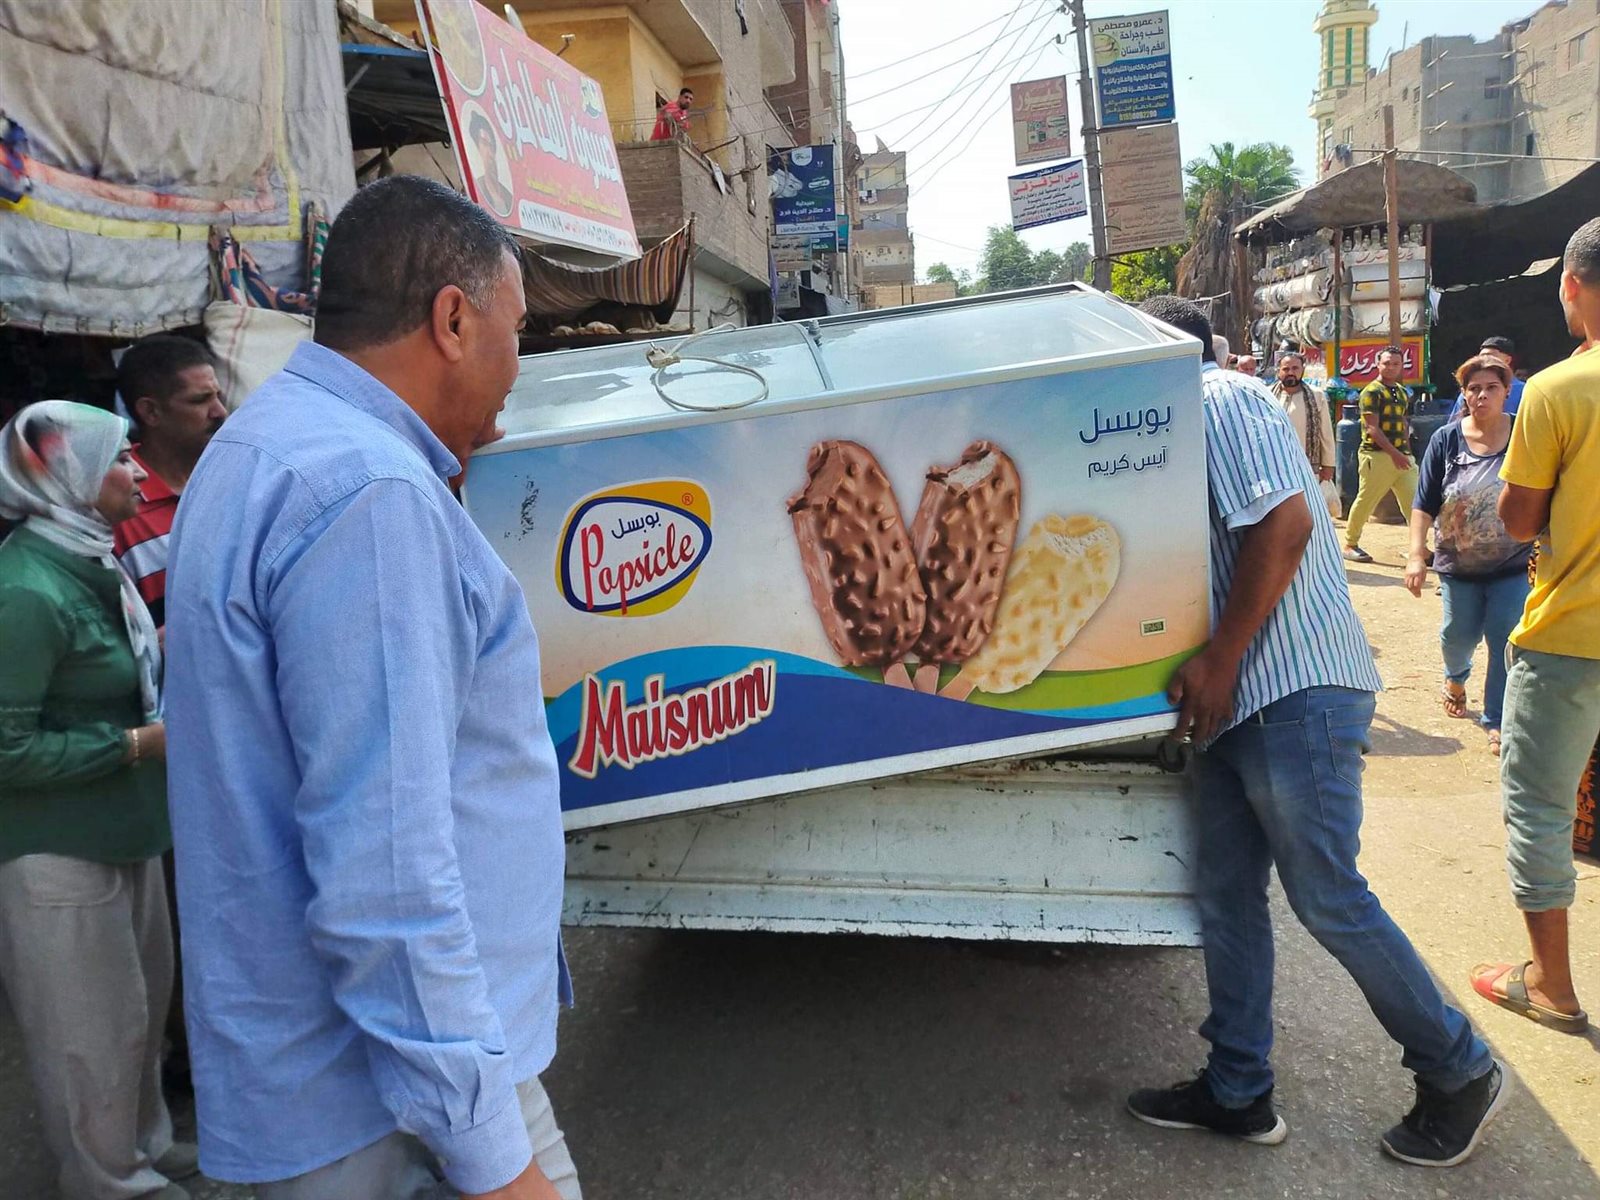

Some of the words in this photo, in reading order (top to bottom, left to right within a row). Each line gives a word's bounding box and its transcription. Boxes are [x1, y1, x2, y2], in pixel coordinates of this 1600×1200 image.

[1120, 29, 1144, 41] وجراحة
[1133, 19, 1154, 28] عمرو
[1079, 405, 1173, 445] بوبسل
[1088, 453, 1130, 478] كريم
[1132, 445, 1169, 472] آيس
[611, 511, 662, 540] بوبسل
[580, 522, 696, 616] Popsicle
[571, 661, 774, 776] Maisnum
